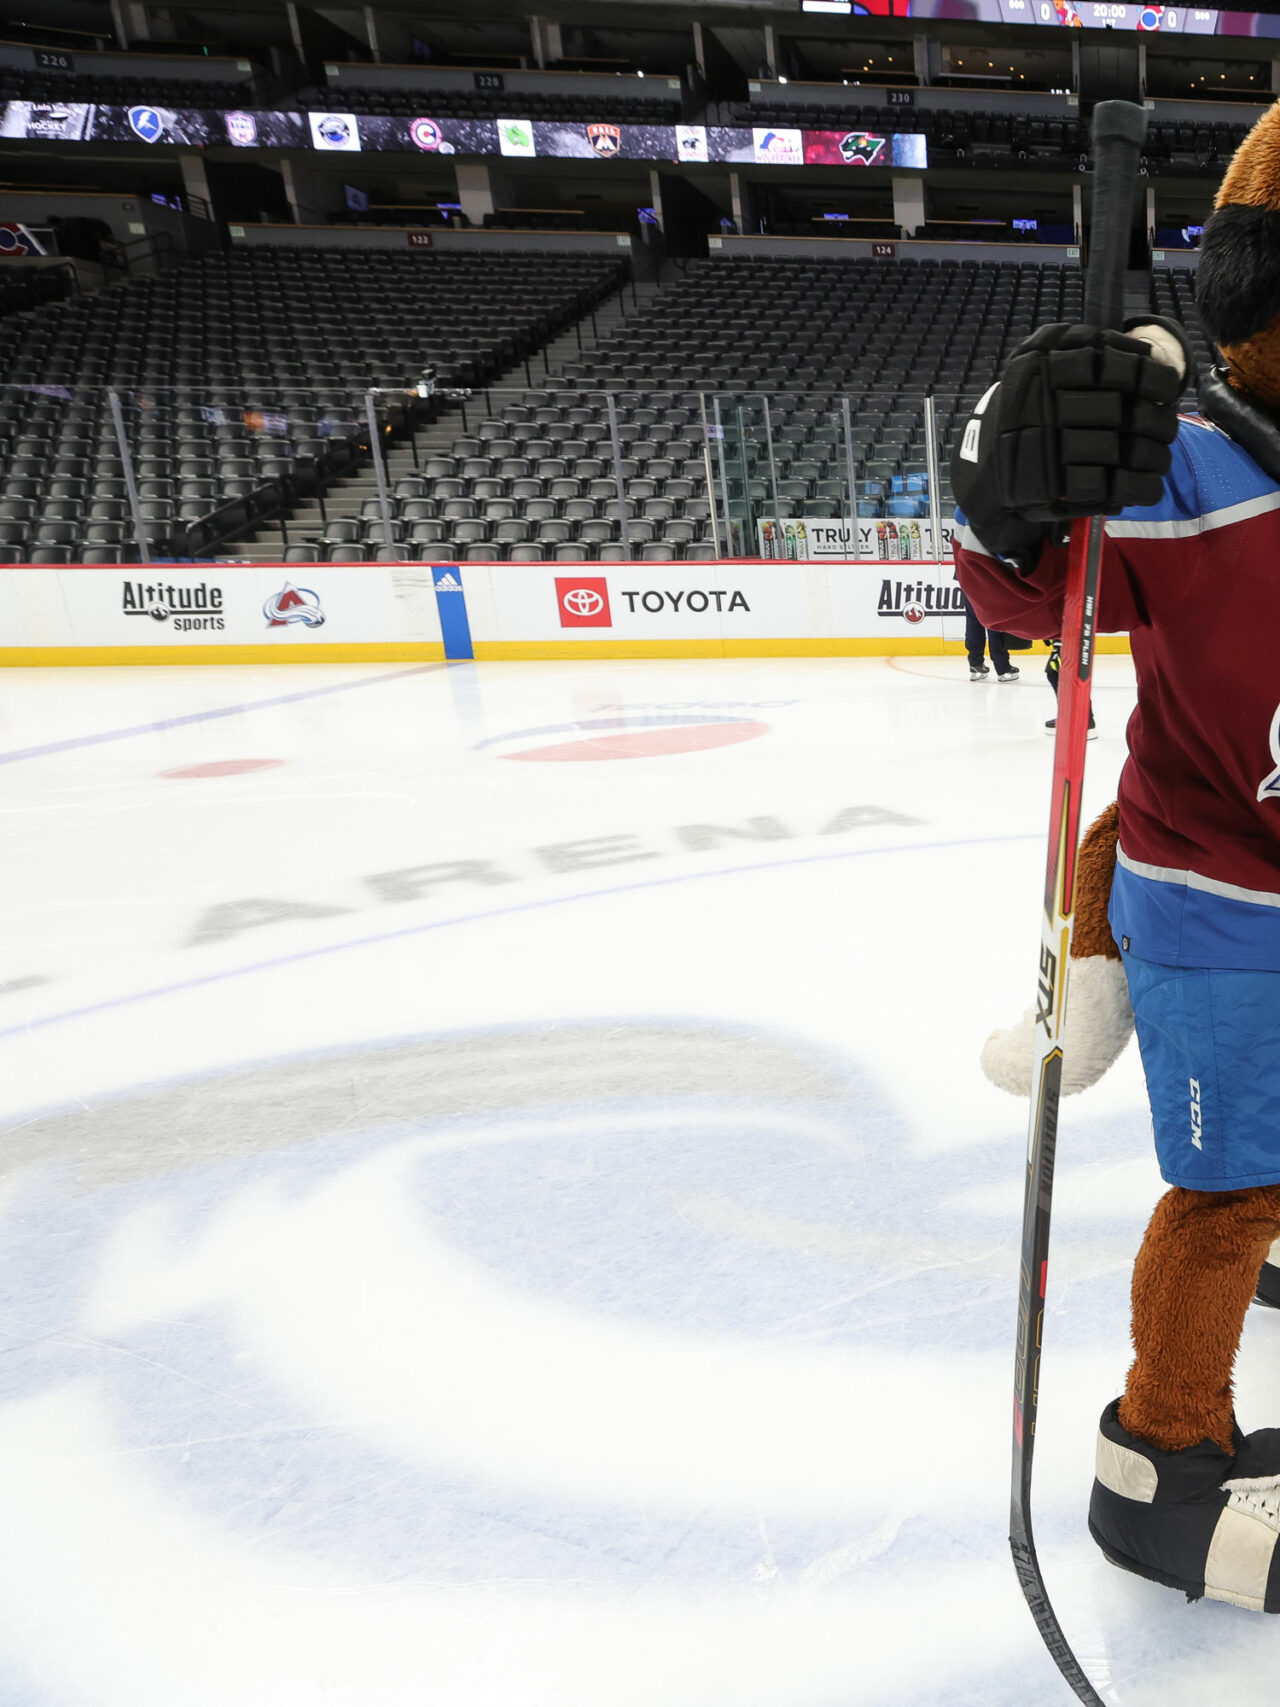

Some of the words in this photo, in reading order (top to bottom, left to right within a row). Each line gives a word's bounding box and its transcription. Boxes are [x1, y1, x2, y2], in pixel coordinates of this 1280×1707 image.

[1093, 4, 1126, 18] 20:00
[41, 54, 69, 68] 226
[891, 92, 909, 103] 230
[876, 246, 892, 256] 124
[811, 527, 873, 543] TRUY
[122, 581, 223, 609] Altitude
[621, 590, 751, 613] TOYOTA
[878, 579, 966, 611] Altitu
[174, 616, 225, 631] sports
[180, 805, 930, 949] ARENA
[1035, 944, 1056, 1038] STX
[1188, 1076, 1203, 1152] CCM
